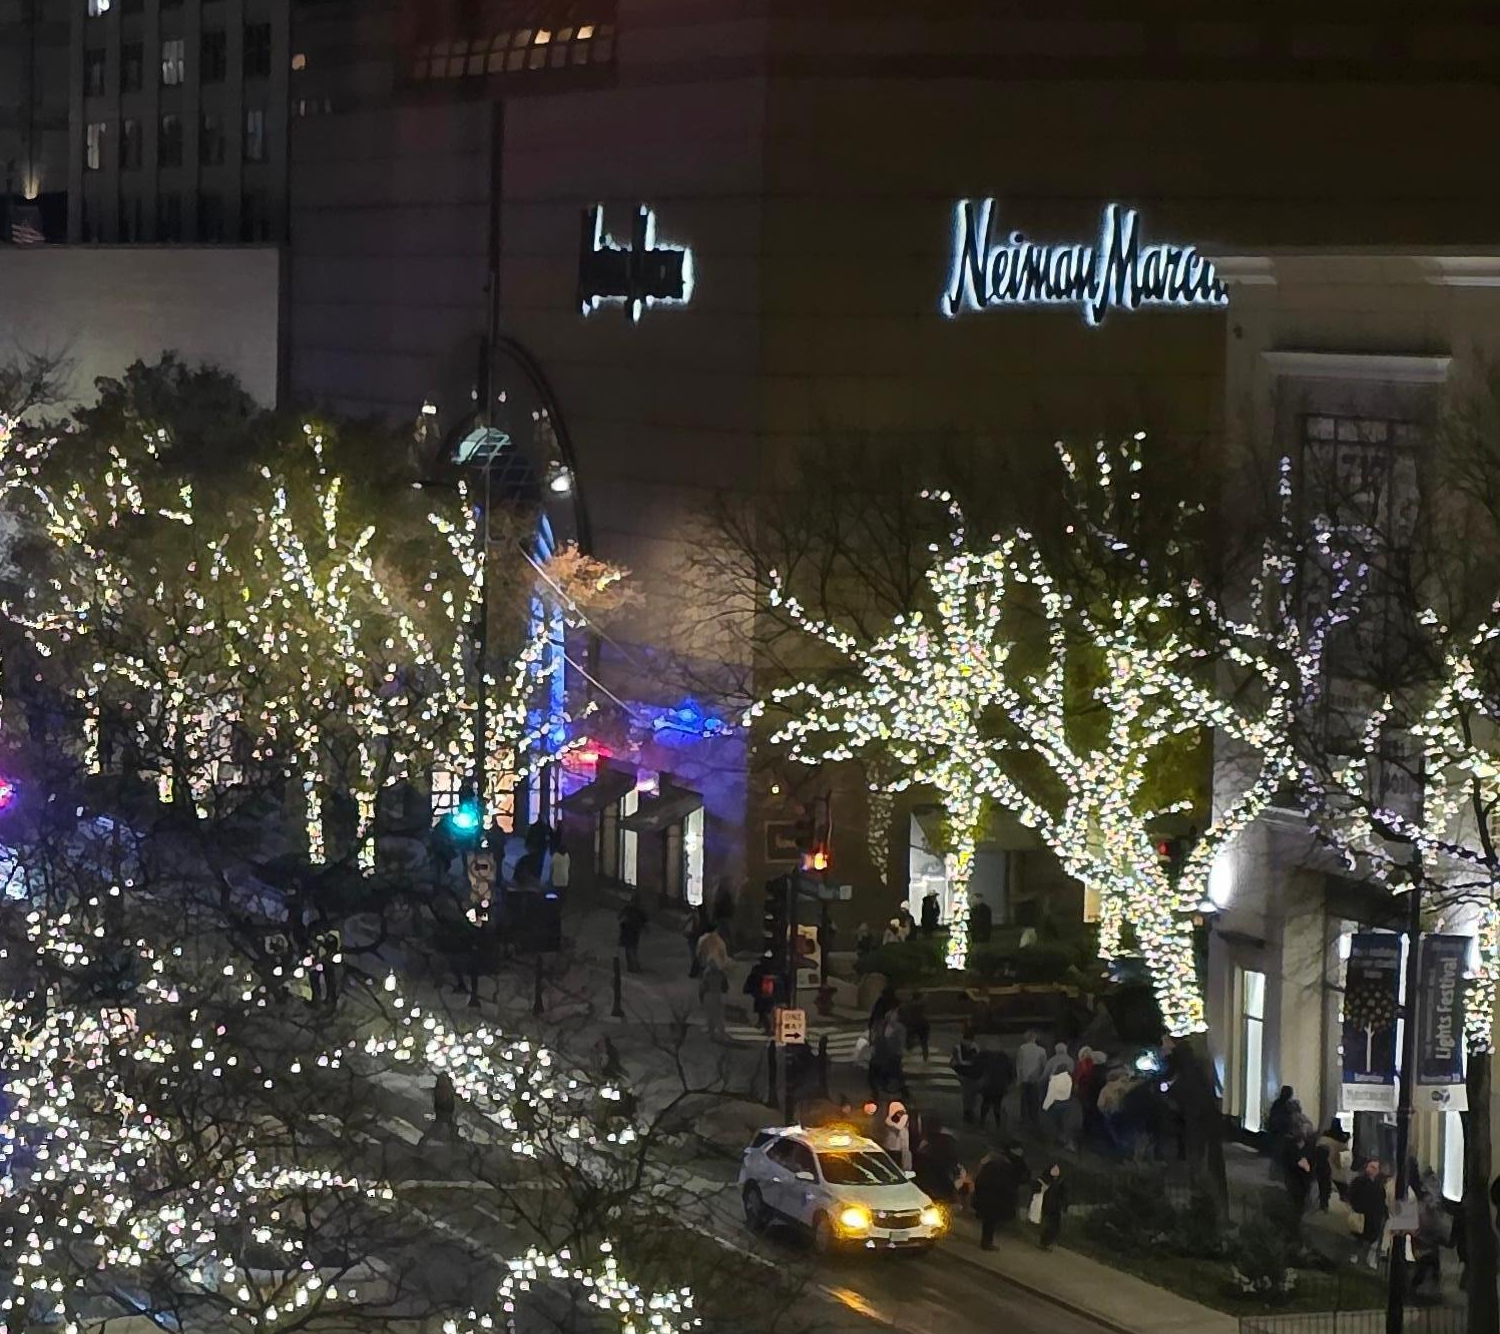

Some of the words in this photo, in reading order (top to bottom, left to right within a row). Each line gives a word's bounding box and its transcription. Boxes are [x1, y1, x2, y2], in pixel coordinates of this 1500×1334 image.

[941, 197, 1100, 315] Neiman
[1436, 957, 1458, 1013] Festival
[1435, 1015, 1456, 1060] Lights
